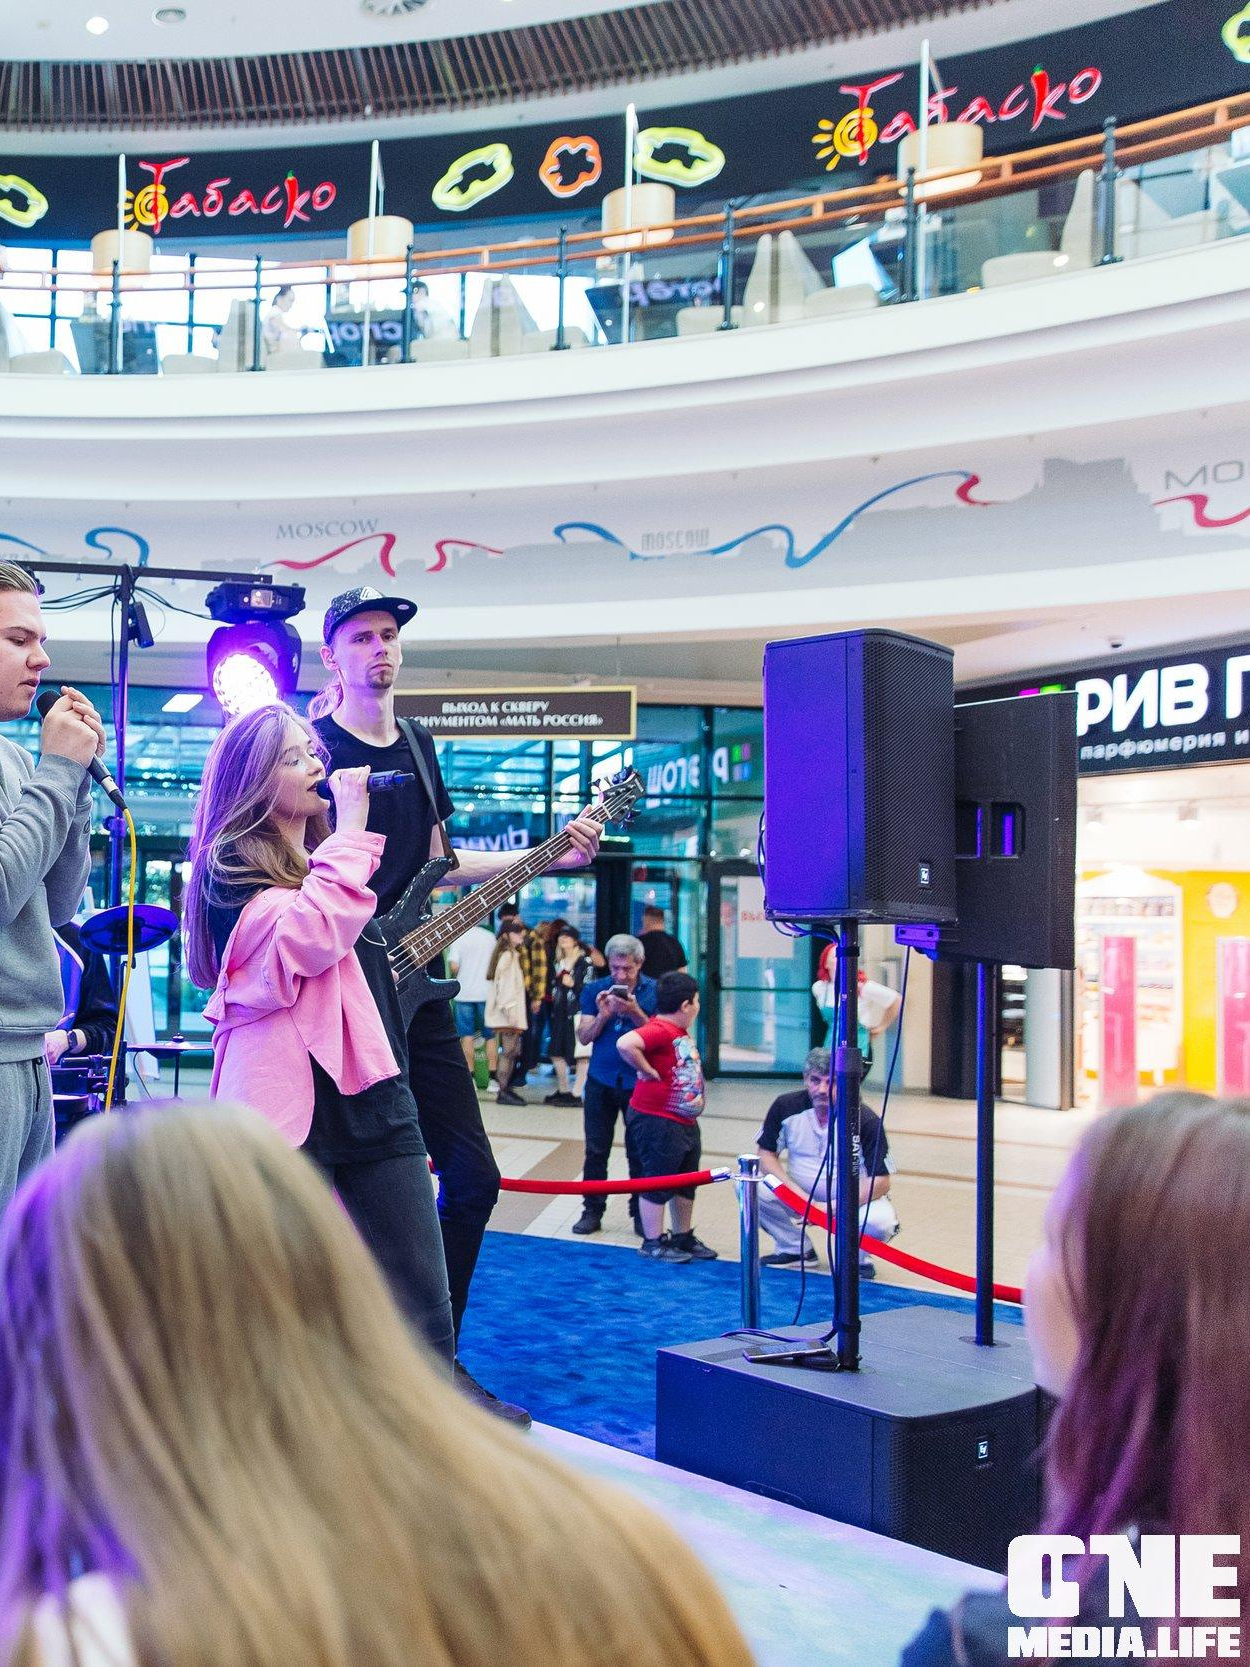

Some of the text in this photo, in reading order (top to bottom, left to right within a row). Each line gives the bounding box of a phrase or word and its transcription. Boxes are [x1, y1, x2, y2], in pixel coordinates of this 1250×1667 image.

[837, 65, 1102, 166] Табаско
[138, 156, 337, 235] Табаско
[276, 518, 379, 540] MOSCOW
[441, 700, 550, 714] ВЫХОД К СКВЕРУ
[1075, 663, 1209, 737] РИВ
[404, 715, 498, 728] ОНУМЕНТОМ
[1080, 731, 1226, 761] парфюмерия
